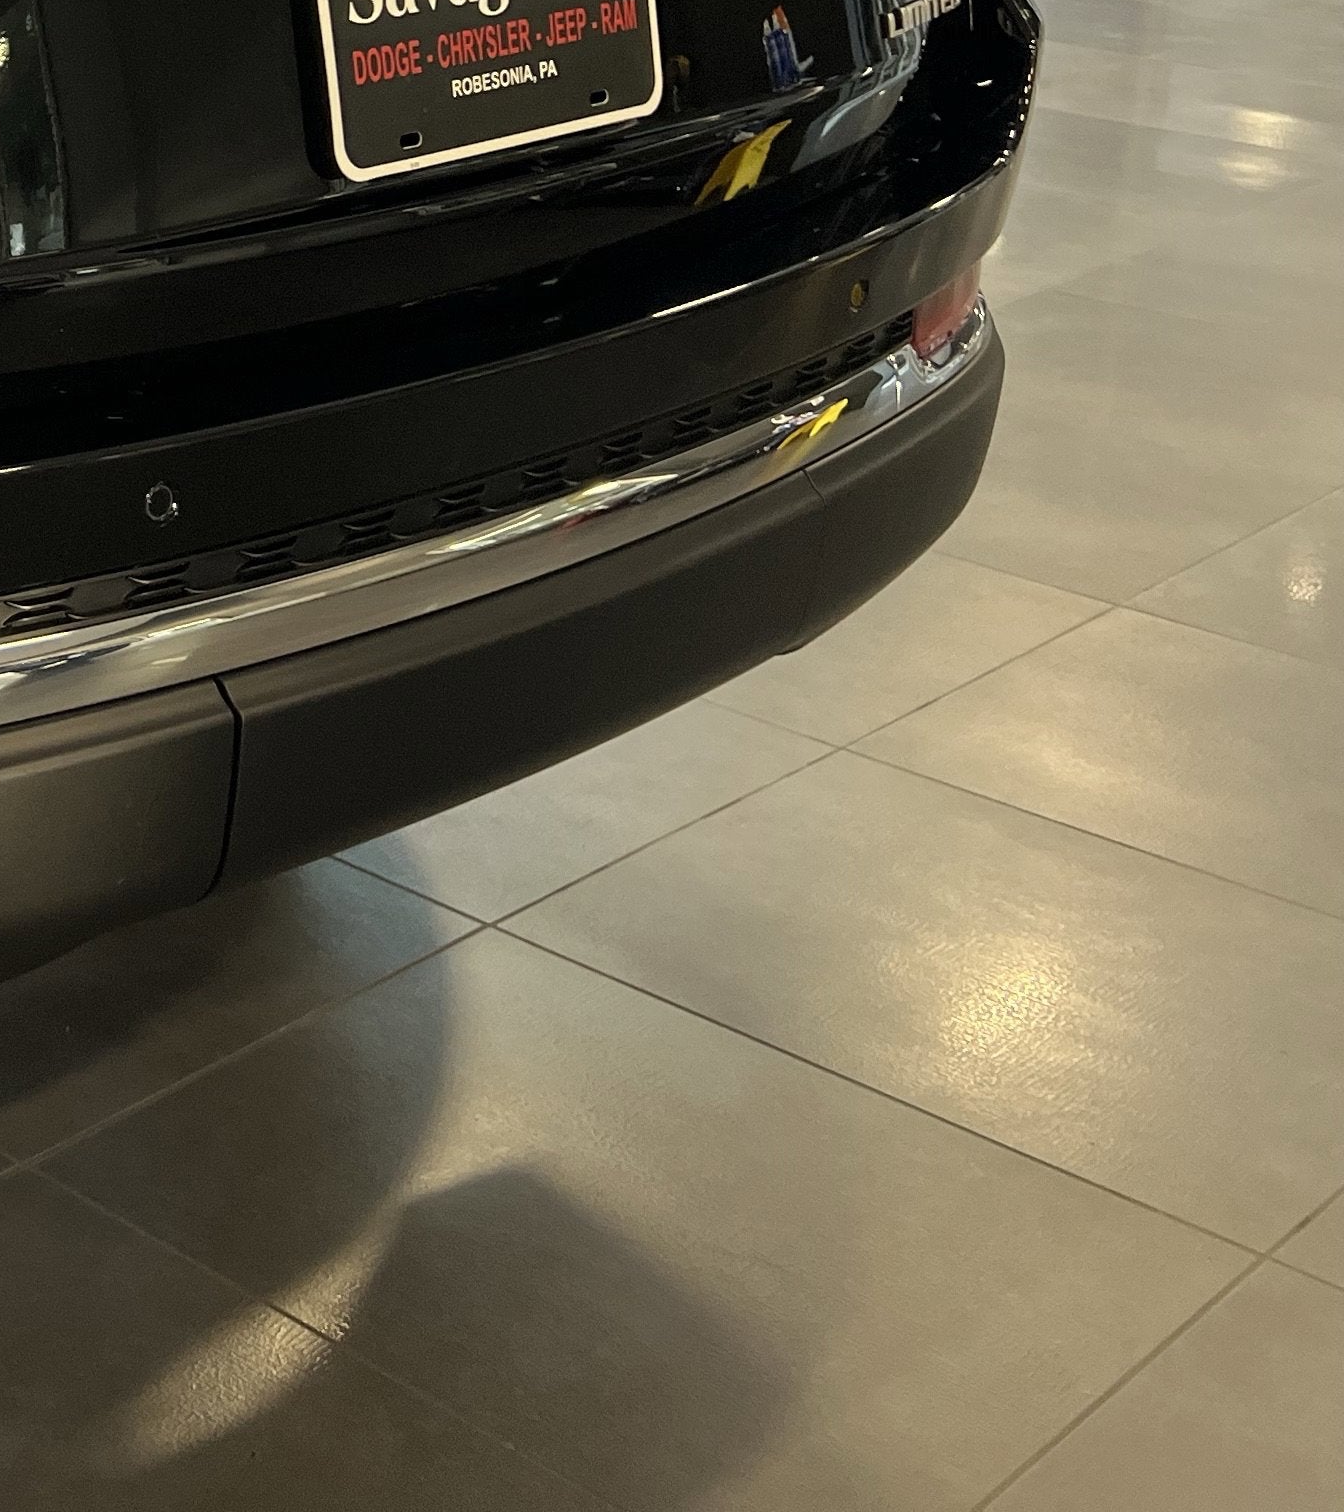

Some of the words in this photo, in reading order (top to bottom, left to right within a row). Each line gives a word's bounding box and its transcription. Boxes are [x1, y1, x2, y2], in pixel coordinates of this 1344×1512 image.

[352, 40, 422, 85] DODGE
[436, 18, 533, 70] CHRYSLER
[545, 7, 587, 48] JEEP
[451, 65, 537, 98] ROBESONIA,
[539, 59, 558, 79] PA
